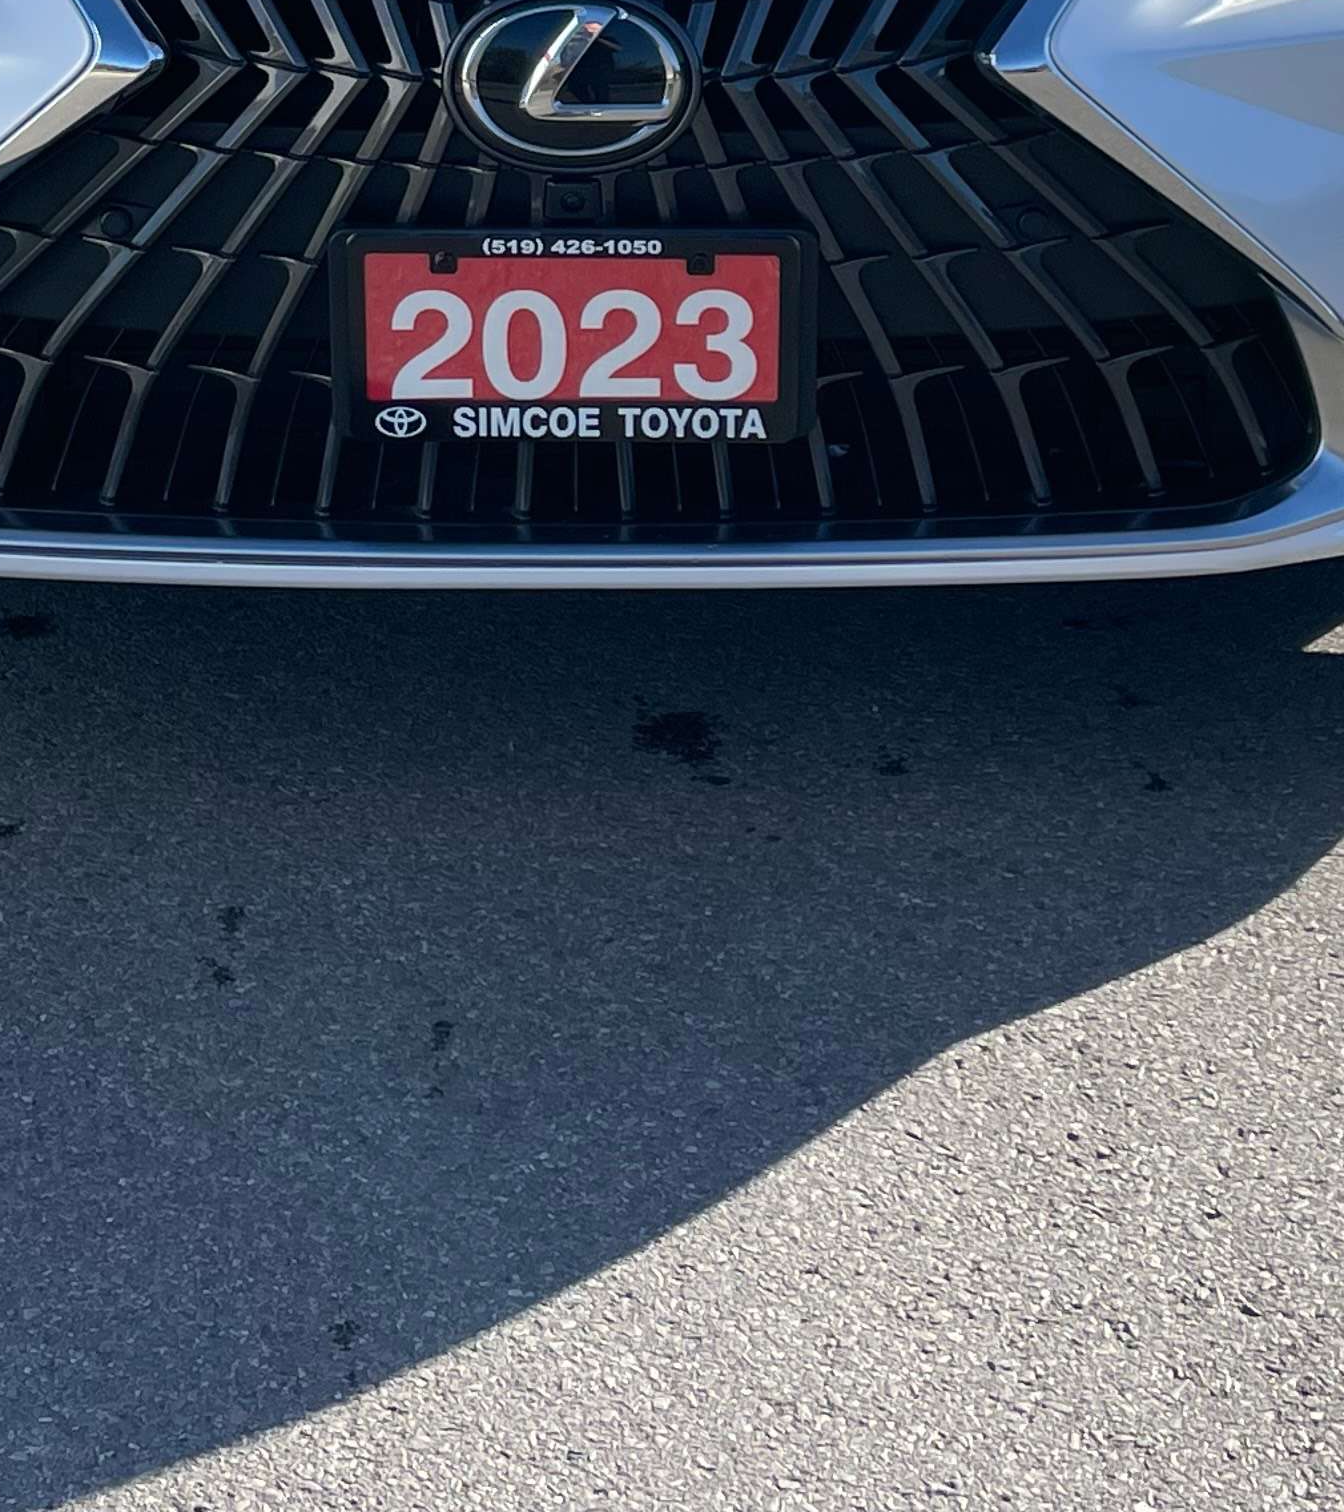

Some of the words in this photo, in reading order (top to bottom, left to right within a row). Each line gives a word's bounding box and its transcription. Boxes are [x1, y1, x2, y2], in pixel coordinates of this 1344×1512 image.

[482, 237, 544, 256] (519)
[550, 239, 663, 255] 426-1050
[391, 289, 757, 401] 2023
[453, 407, 600, 438] SIMCOE
[618, 407, 767, 439] TOYOTA
